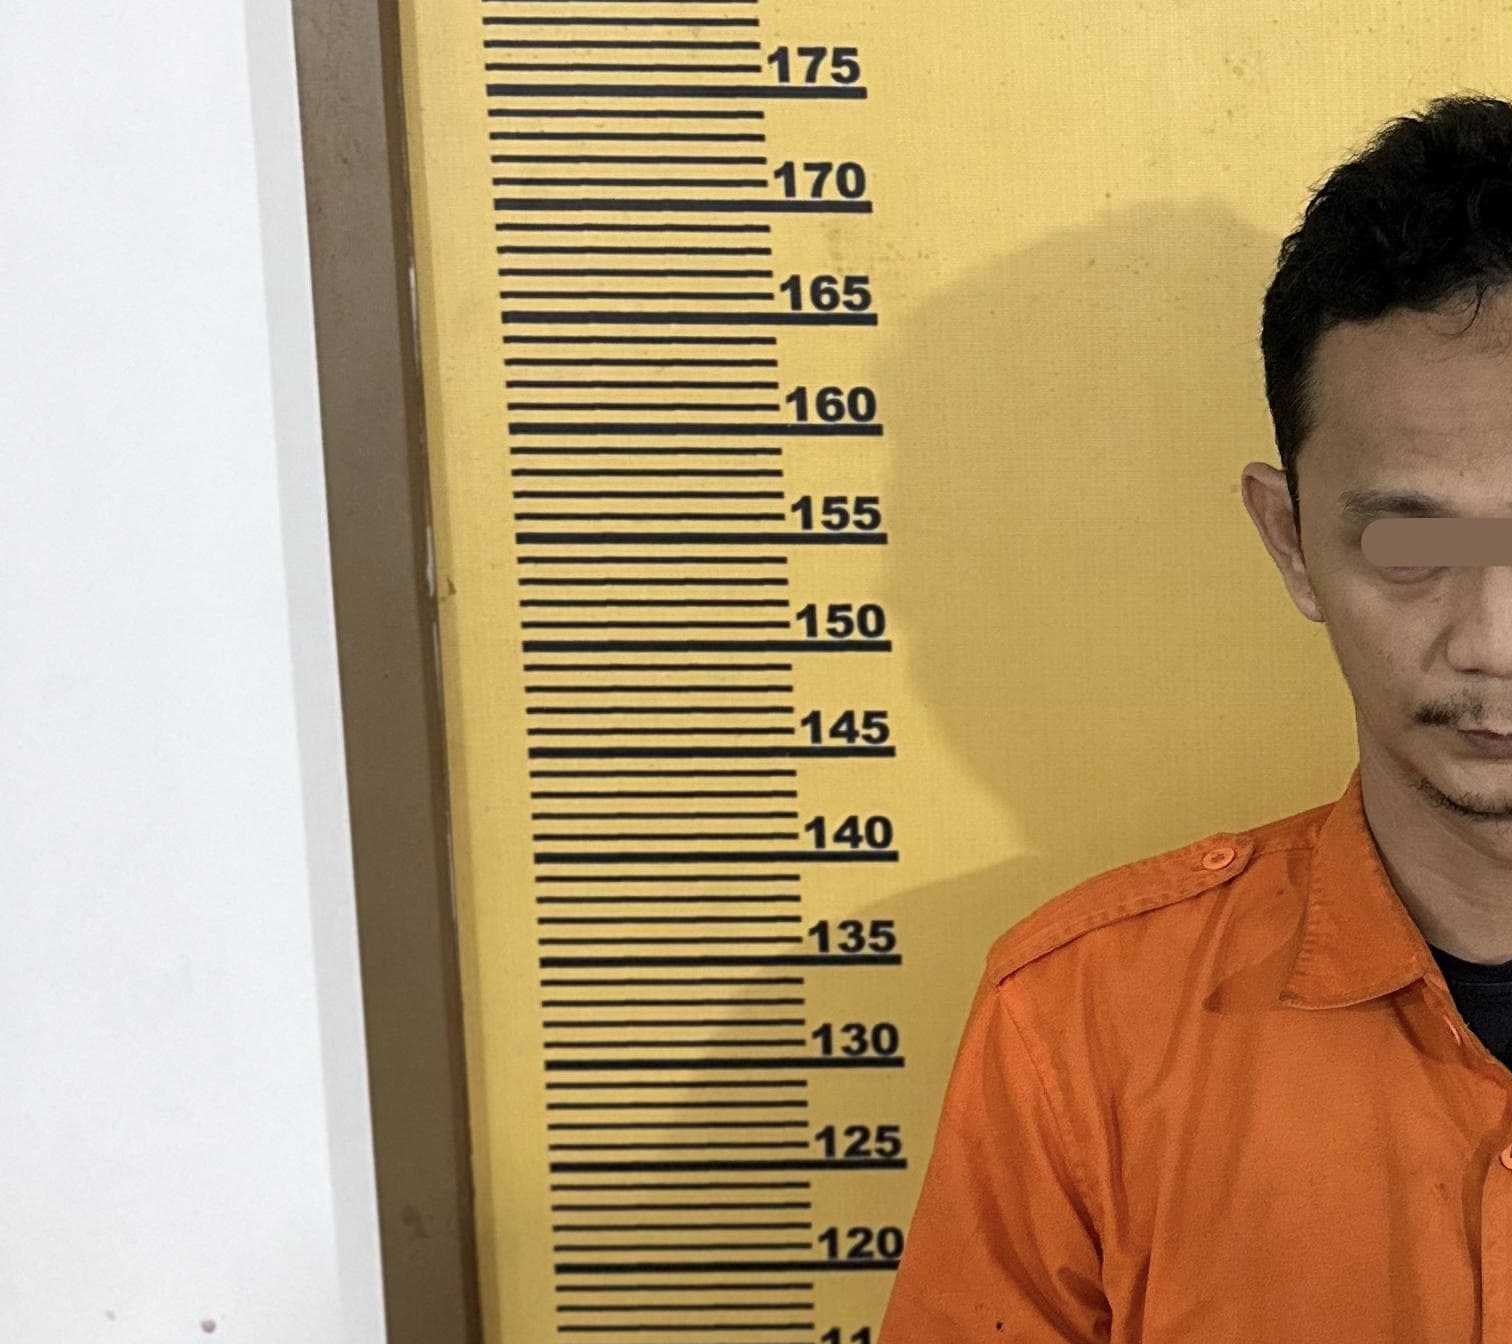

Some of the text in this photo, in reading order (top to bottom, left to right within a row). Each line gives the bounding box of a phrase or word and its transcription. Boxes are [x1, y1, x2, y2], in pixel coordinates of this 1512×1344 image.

[768, 47, 860, 84] 175
[774, 161, 865, 199] 170
[780, 275, 871, 311] 165
[786, 387, 876, 422] 160
[791, 496, 881, 531] 155
[796, 604, 885, 638] 150
[801, 710, 889, 745] 145
[805, 815, 893, 849] 140
[809, 920, 896, 954] 135
[812, 1022, 899, 1056] 130
[815, 1125, 901, 1158] 125
[818, 1226, 904, 1260] 120
